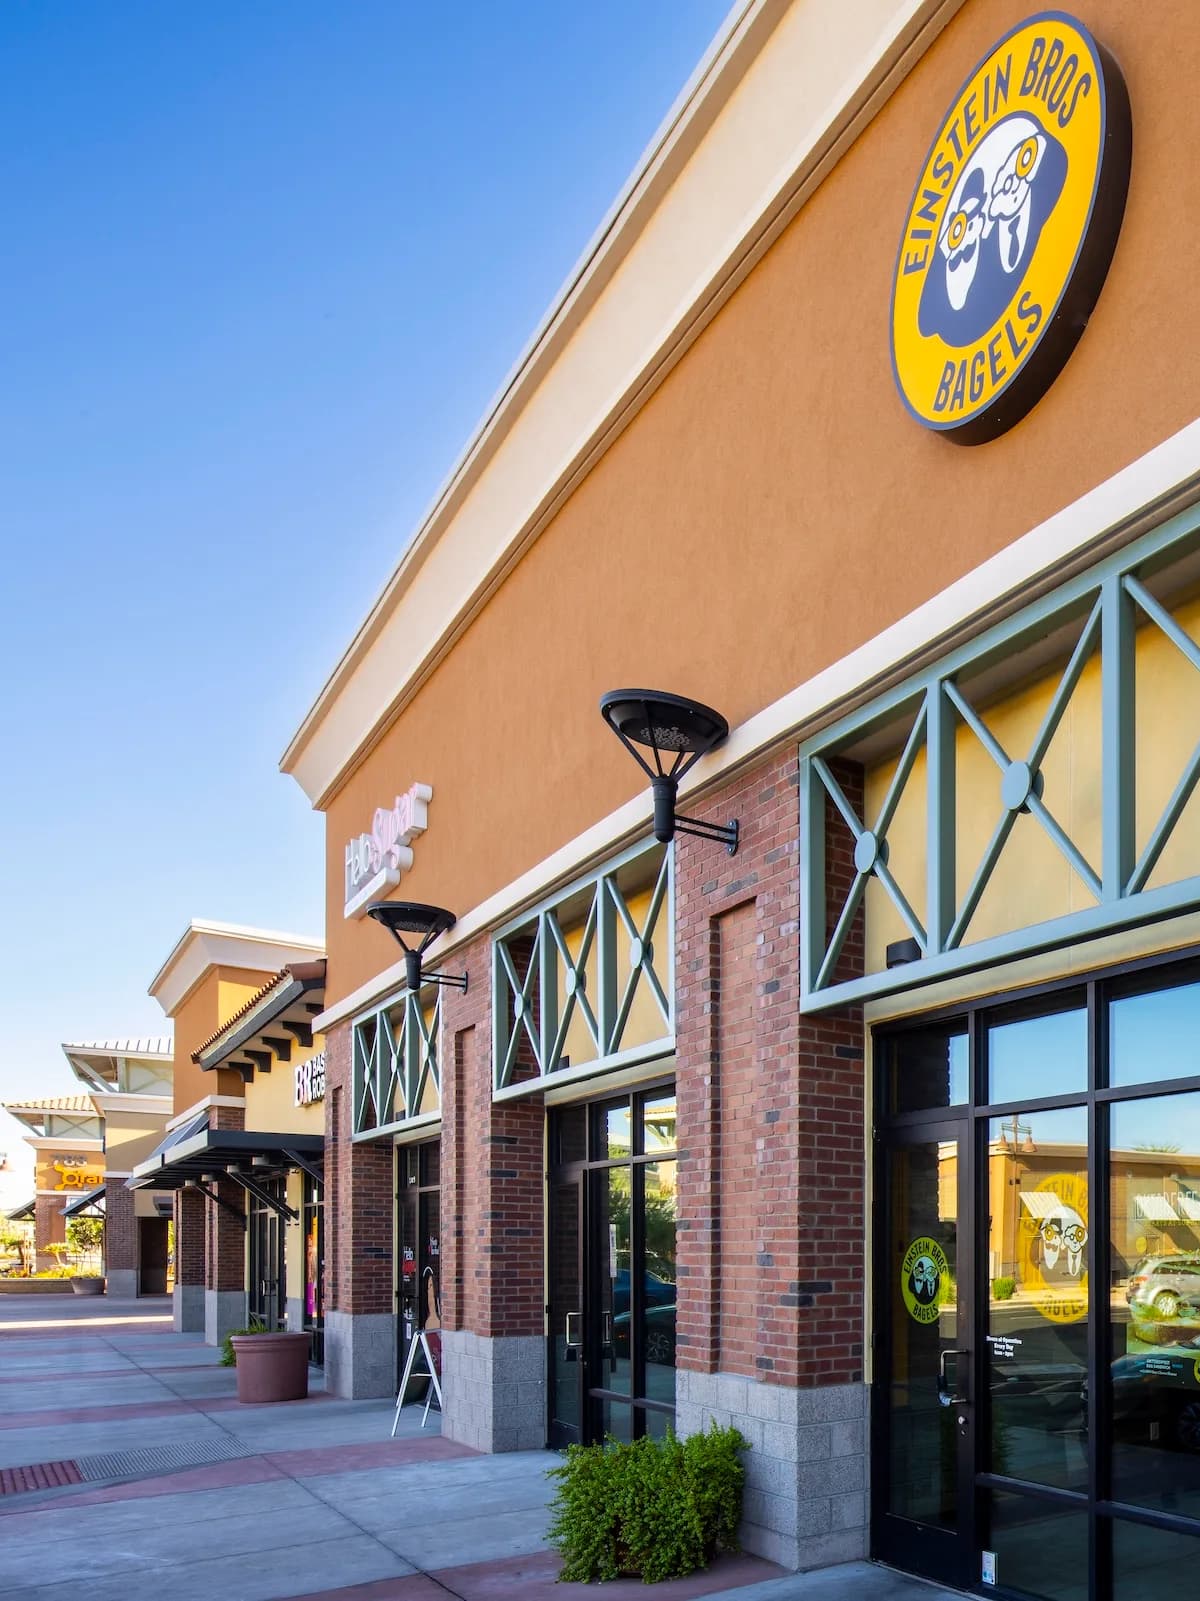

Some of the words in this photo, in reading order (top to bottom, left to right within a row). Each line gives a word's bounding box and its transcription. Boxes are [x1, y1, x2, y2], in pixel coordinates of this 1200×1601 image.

[903, 53, 1013, 276] EINSTEIN
[1019, 37, 1091, 128] BROS
[932, 291, 1043, 413] BAGELS
[295, 1060, 312, 1106] BR
[904, 1241, 930, 1274] EINSTEIN
[932, 1245, 947, 1274] BROS
[913, 1304, 939, 1320] BAGELS
